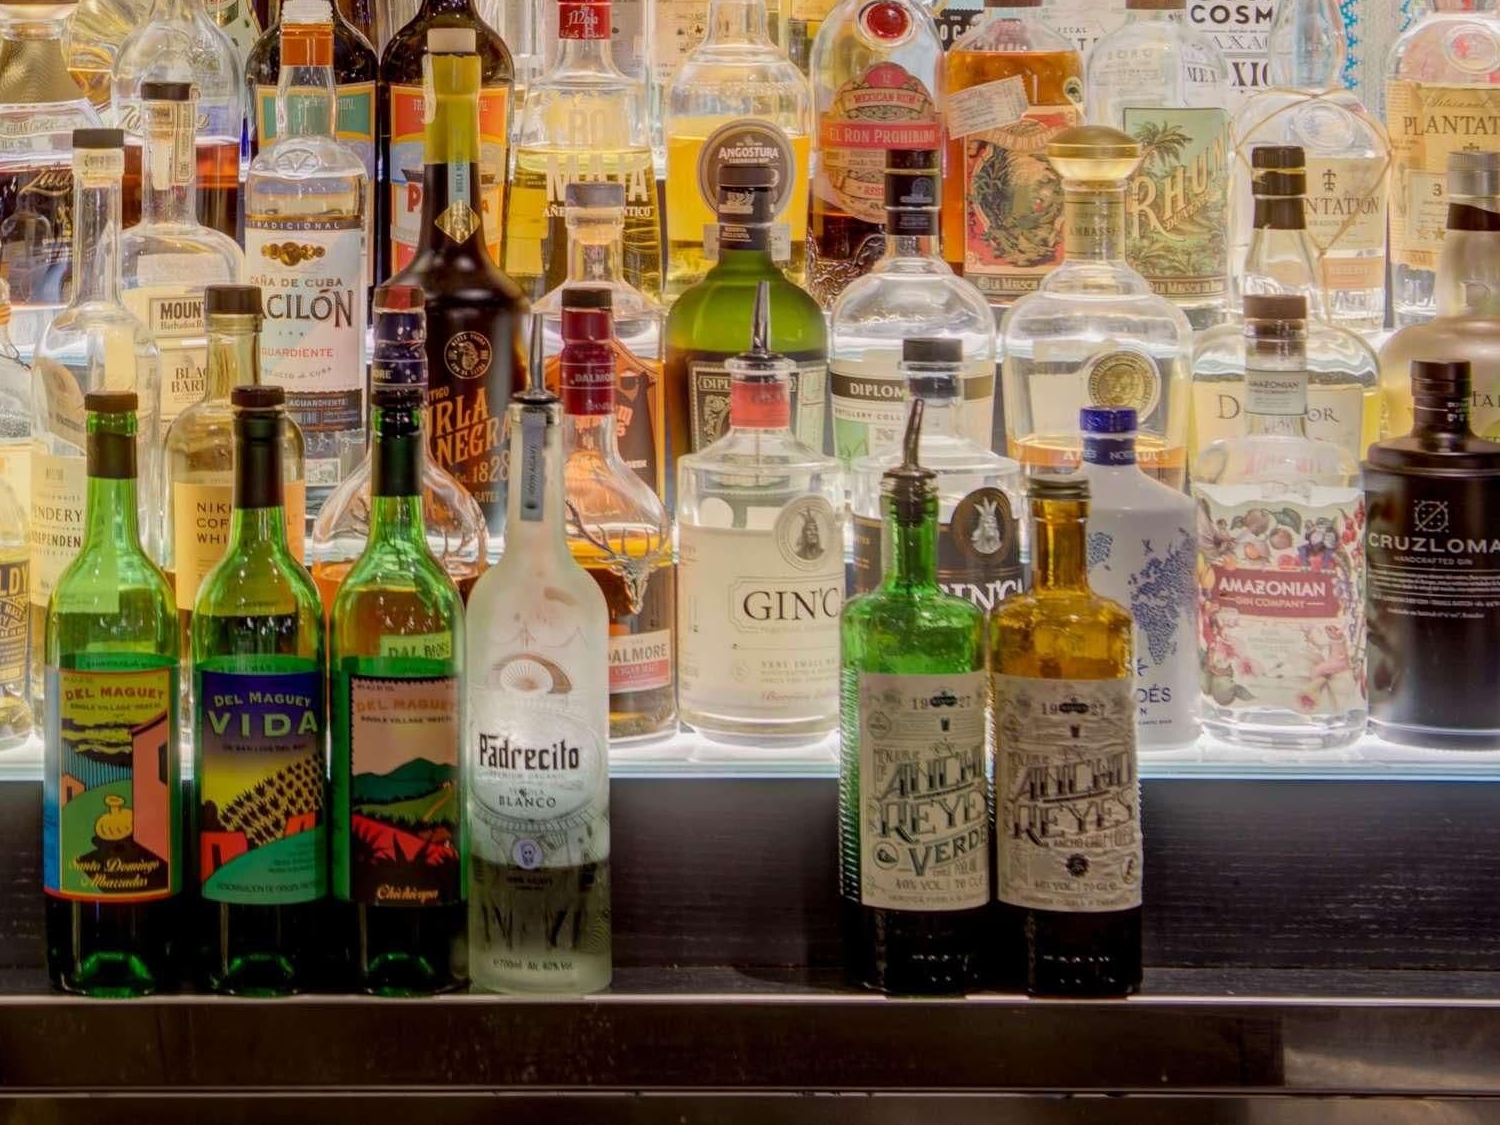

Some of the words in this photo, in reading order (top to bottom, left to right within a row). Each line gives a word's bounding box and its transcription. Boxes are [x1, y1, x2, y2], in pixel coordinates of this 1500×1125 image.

[1191, 5, 1273, 24] COSM
[829, 127, 841, 141] EL
[844, 127, 870, 142] RON
[718, 146, 780, 159] ANGOSTURA
[1128, 128, 1228, 241] RHUM
[1301, 197, 1380, 216] NTATION
[250, 221, 340, 230] TRADICIONAL
[281, 279, 299, 288] DE
[305, 278, 344, 288] CUBA
[160, 301, 205, 320] MOUN
[261, 289, 354, 328] CILÓN
[261, 348, 333, 358] GUARDIENTE
[850, 383, 911, 400] DIPLOM
[436, 410, 511, 467] NEGRA
[196, 502, 231, 514] NIK
[197, 518, 229, 529] COF
[197, 532, 227, 545] WHI
[1367, 532, 1500, 555] CRUZLOMA
[1393, 555, 1455, 565] HANDCRAFTED
[1219, 577, 1326, 597] AMAZONIAN
[608, 643, 667, 662] ALMORE
[65, 687, 96, 701] DEL
[100, 687, 164, 700] MAGUEY
[214, 694, 243, 708] DEL
[250, 692, 312, 707] MAGUEY
[393, 696, 455, 712] MAGUE
[208, 711, 318, 737] VIDA
[881, 745, 988, 806] ANCH
[499, 795, 557, 808] BLANCO
[880, 790, 988, 844] REYE
[1012, 788, 1134, 847] REYES
[908, 824, 988, 876] VERDE
